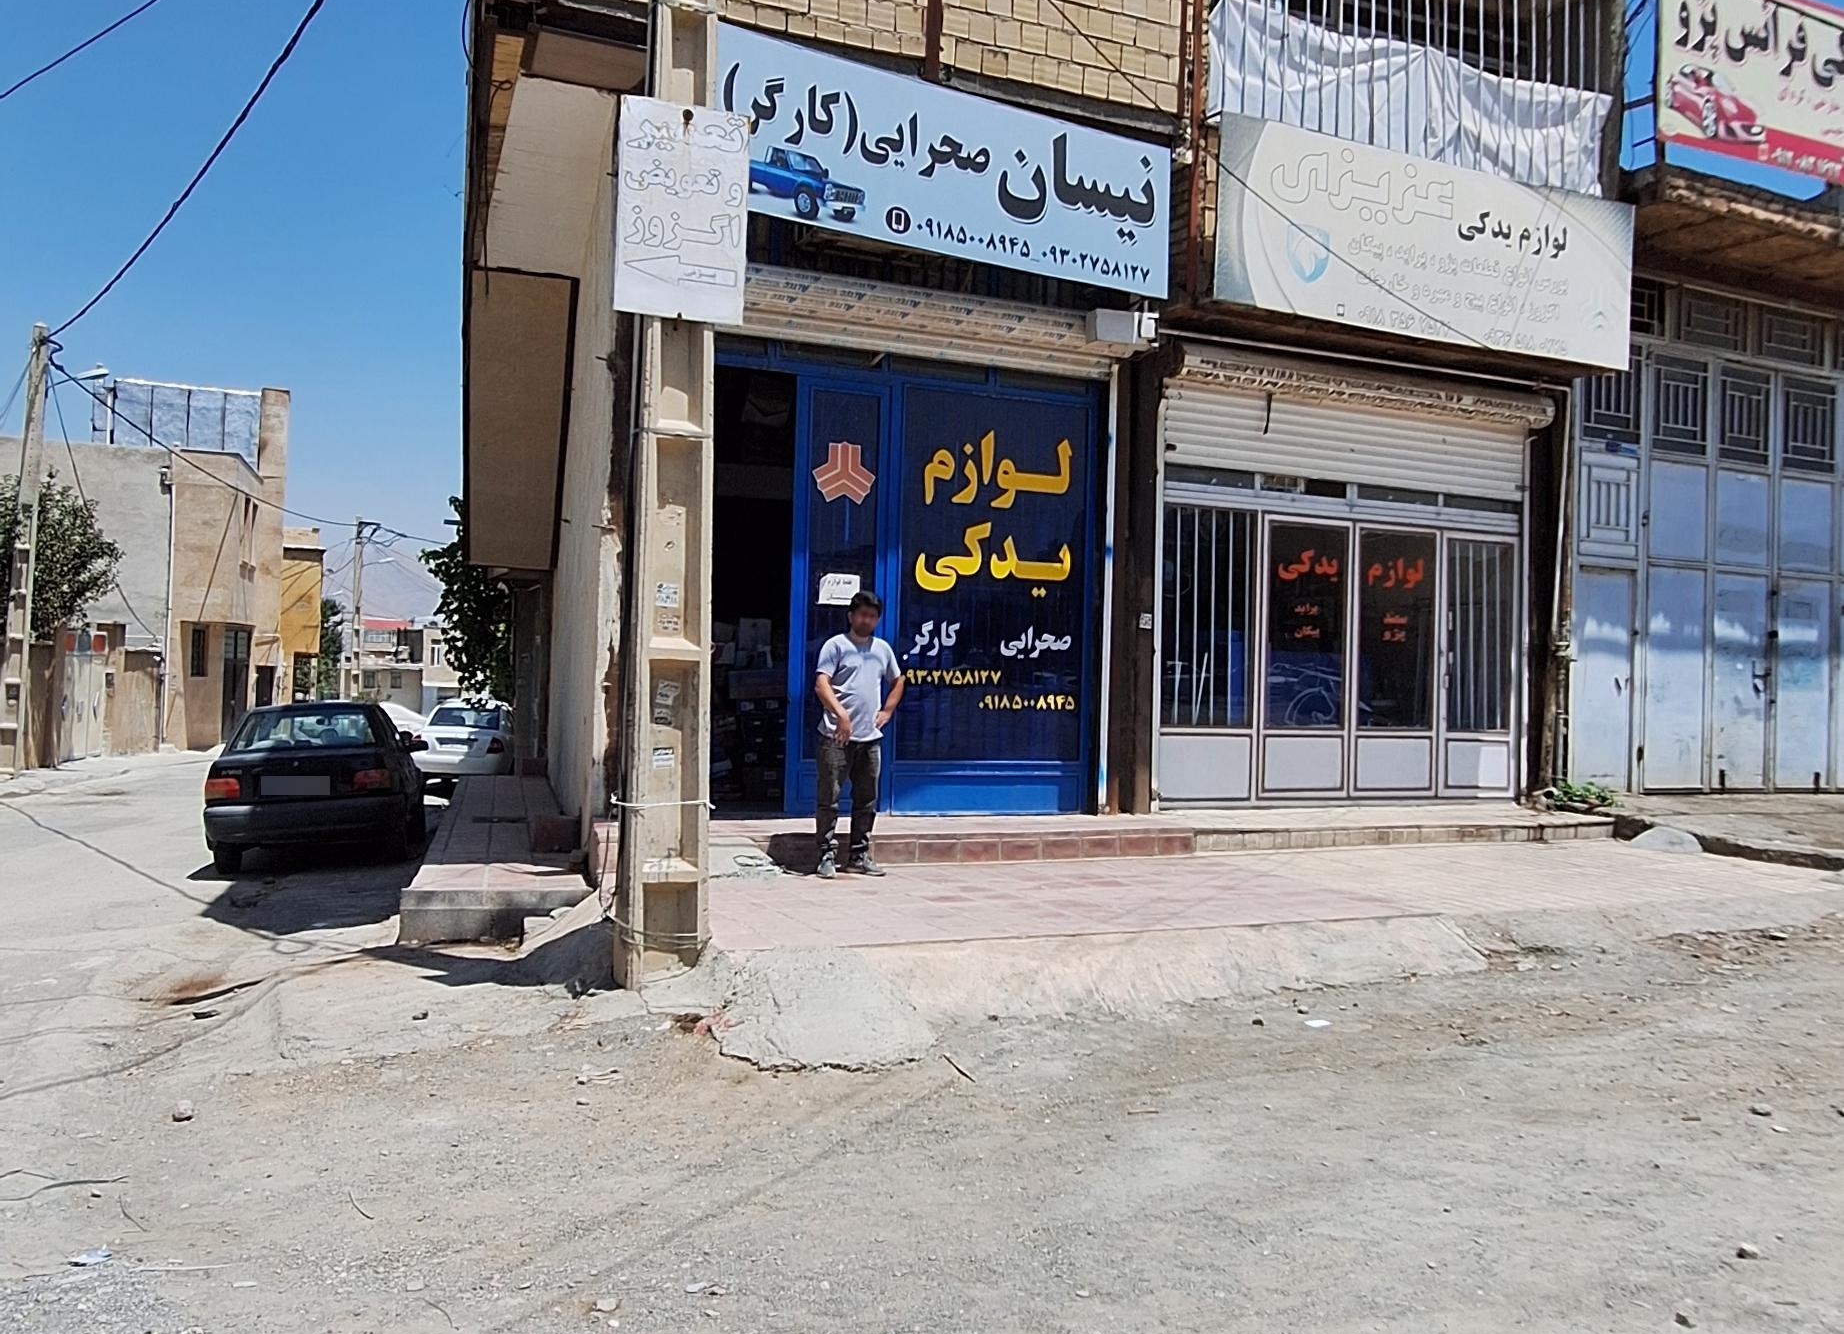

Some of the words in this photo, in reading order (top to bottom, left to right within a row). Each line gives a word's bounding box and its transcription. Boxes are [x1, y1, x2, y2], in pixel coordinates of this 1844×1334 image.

[624, 158, 721, 199] تعویض
[997, 132, 1156, 243] نیسان
[1270, 148, 1453, 225] عزیزی
[624, 205, 741, 251] اگزوز
[1457, 210, 1512, 248] یدکی
[1518, 224, 1568, 259] لوازم
[1348, 233, 1385, 262] پیکان
[923, 429, 1073, 509] لوازم
[915, 521, 1072, 598] یدکی
[1277, 548, 1338, 582] یدکی
[1367, 557, 1425, 589] لوازم
[909, 620, 961, 657] کارگر
[1000, 624, 1072, 660] صحرایی
